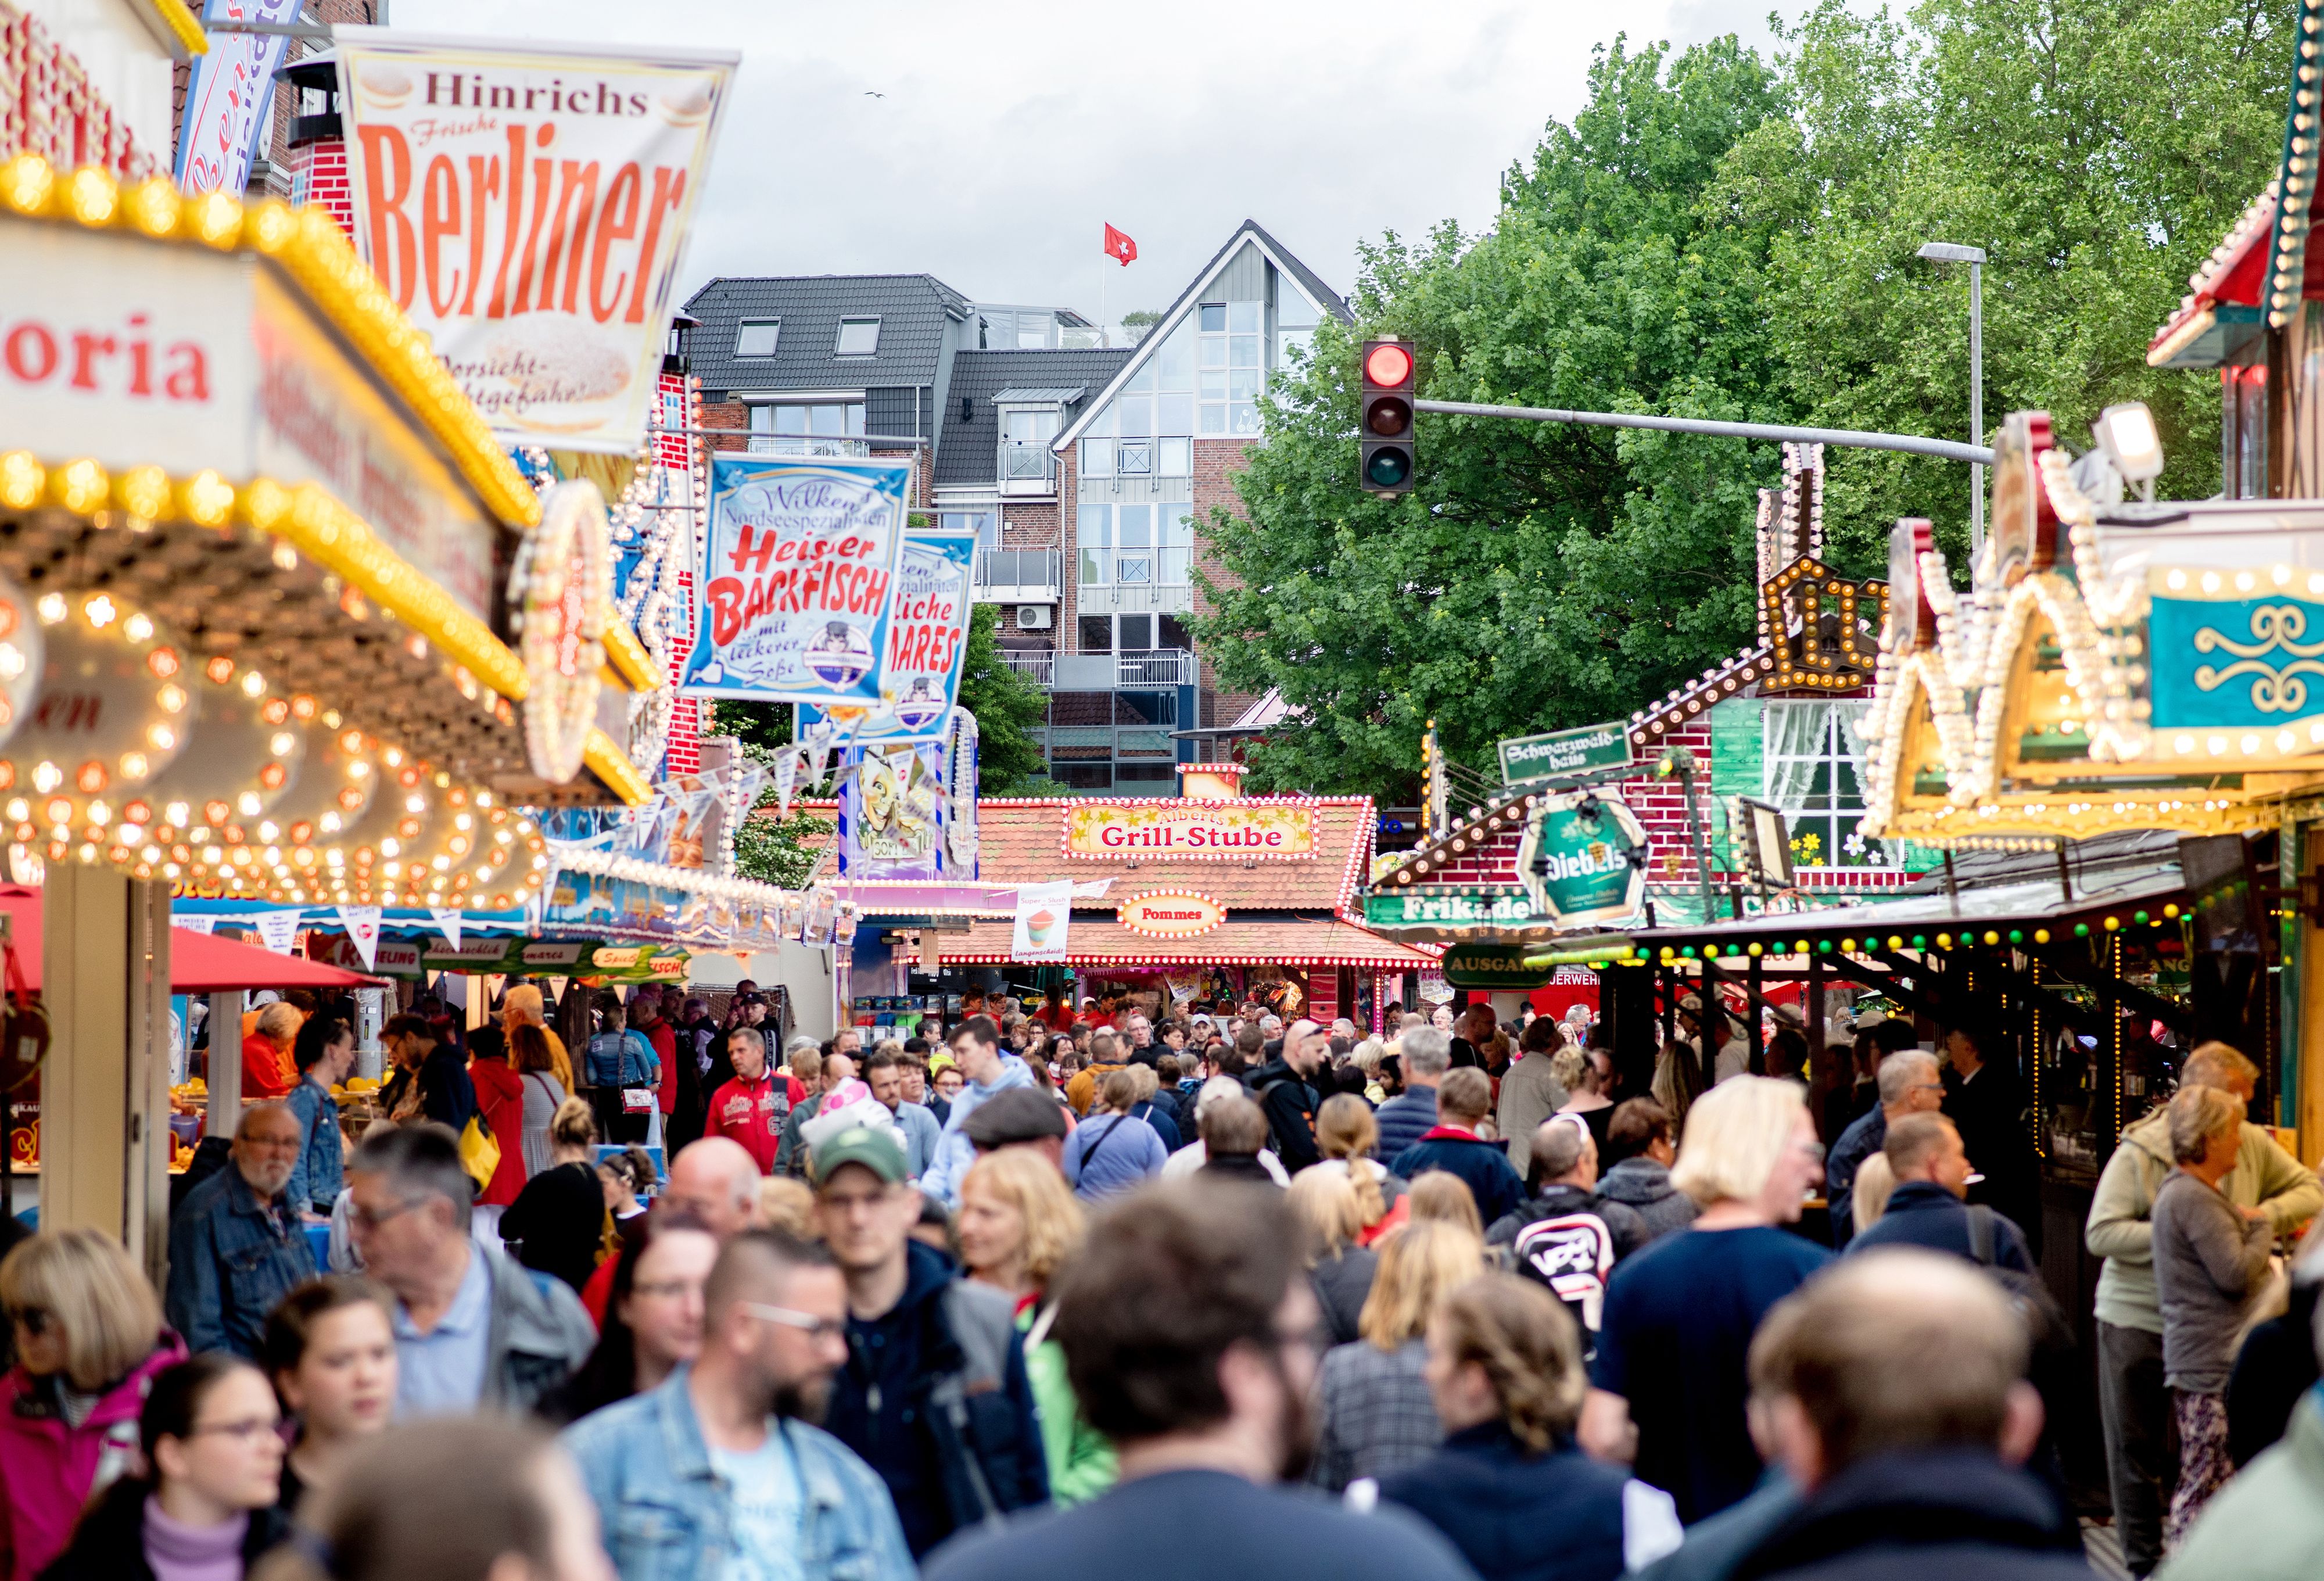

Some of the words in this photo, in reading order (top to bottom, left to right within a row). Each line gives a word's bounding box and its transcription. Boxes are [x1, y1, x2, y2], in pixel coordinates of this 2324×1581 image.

[425, 70, 650, 117] Hinrichs
[410, 114, 498, 146] Frische
[356, 122, 687, 324] Berliner
[707, 561, 889, 646] BACKFISCH
[1549, 753, 1587, 772] haus
[1159, 809, 1226, 826] Alberts
[1101, 826, 1282, 848] Grill-Stube
[1142, 908, 1202, 920] Pommes
[1015, 948, 1063, 957] Langenscheidt
